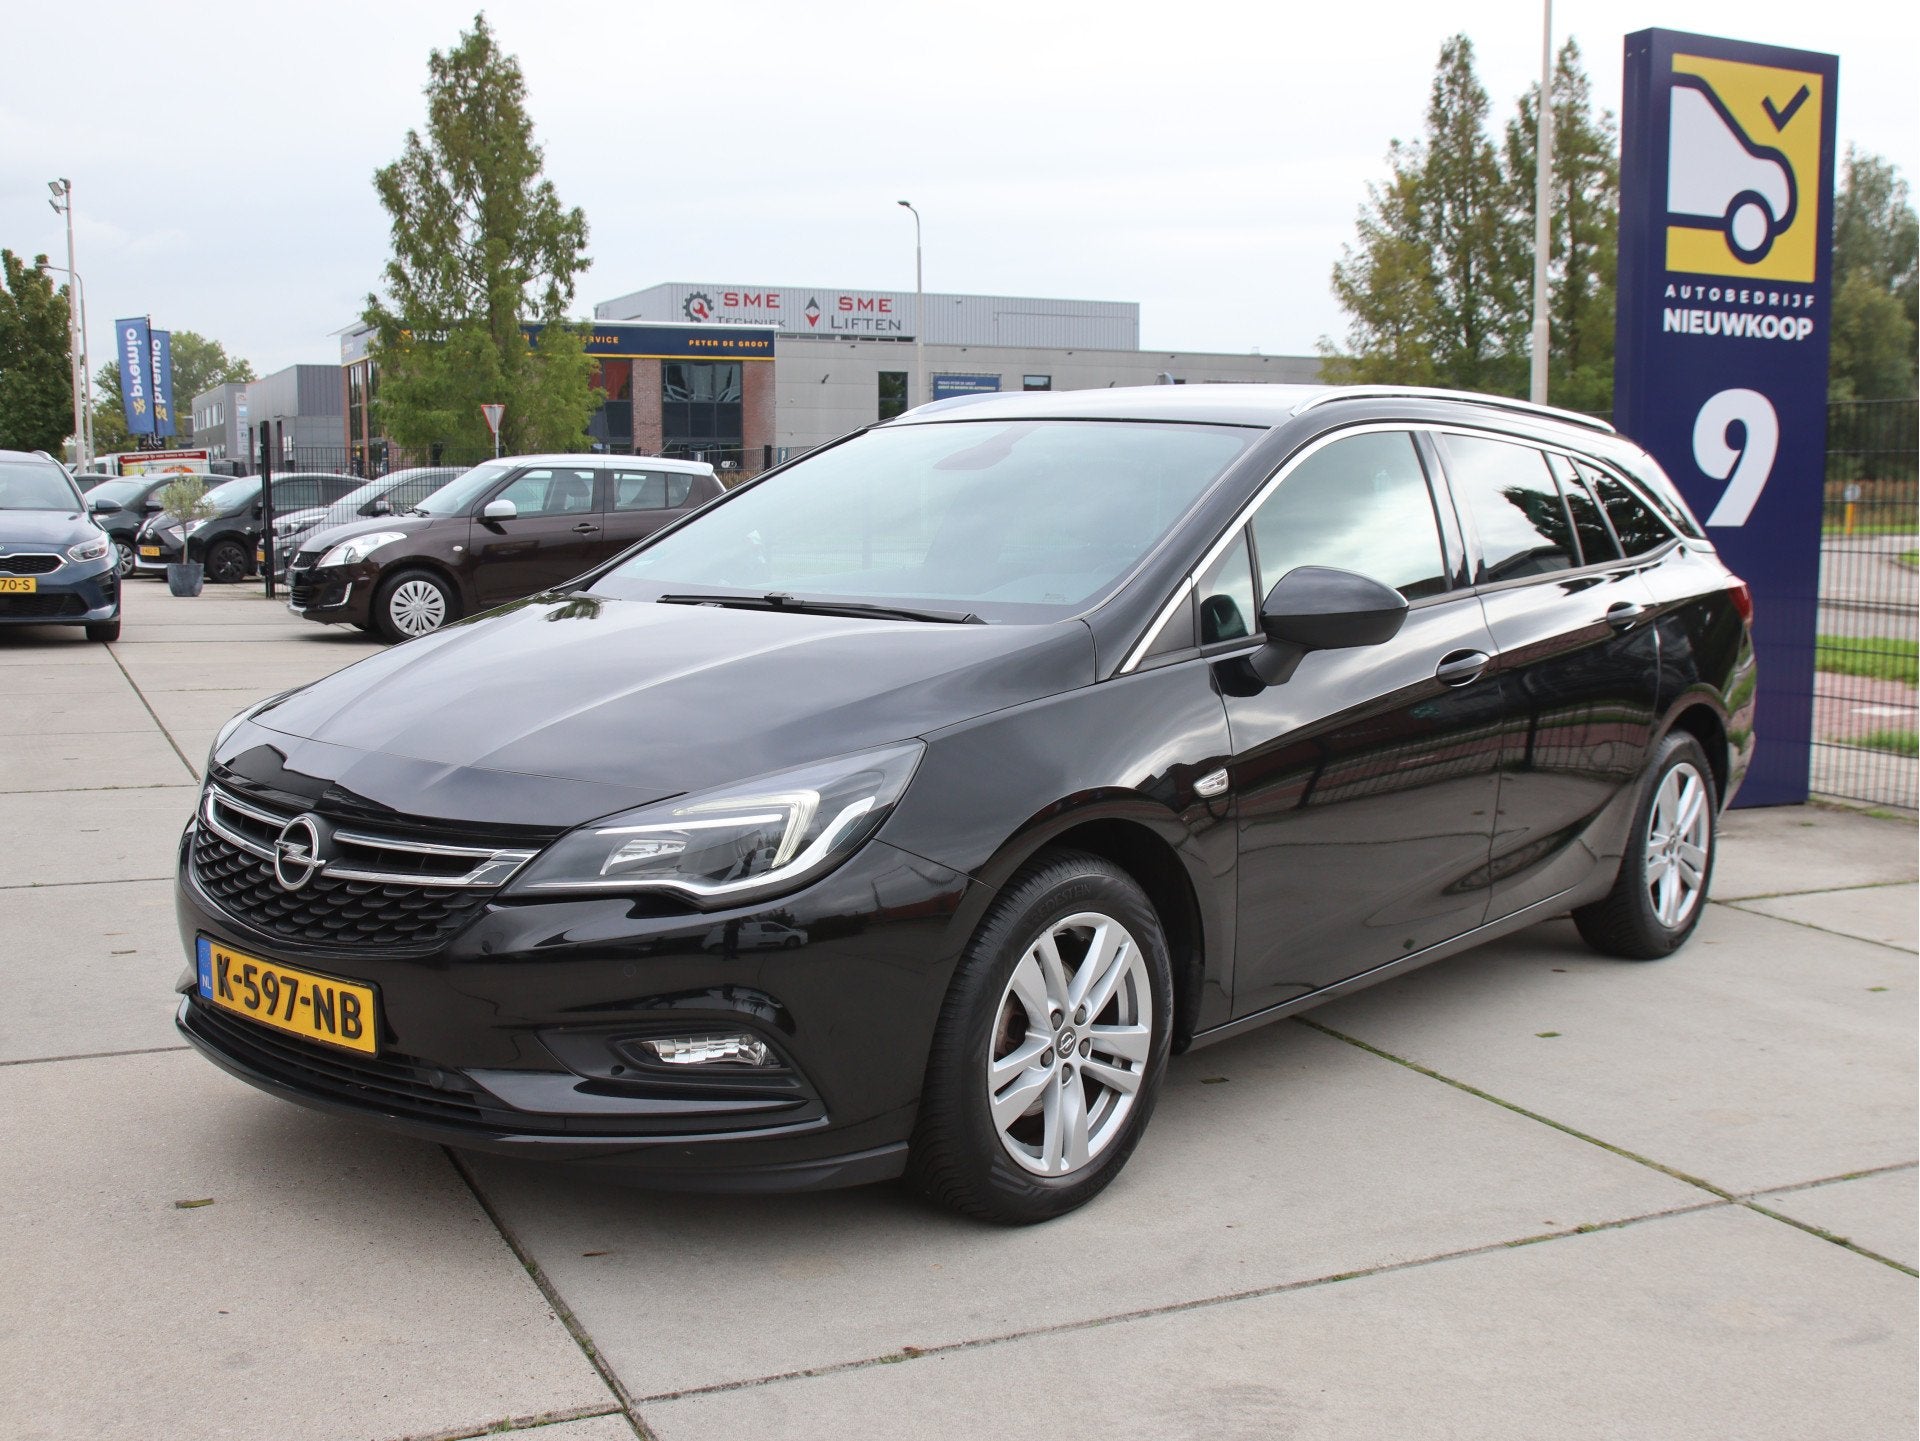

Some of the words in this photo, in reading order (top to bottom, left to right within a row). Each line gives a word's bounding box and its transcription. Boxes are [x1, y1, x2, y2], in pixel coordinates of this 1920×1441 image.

[723, 292, 781, 309] SME
[838, 297, 893, 313] SME
[1664, 284, 1816, 308] AUTOBEDRIJF
[830, 315, 902, 331] LIFTEN
[1662, 308, 1815, 341] NIEUWKOOP
[688, 339, 719, 347] PETER
[738, 340, 769, 348] GROOT
[151, 338, 167, 412] premio
[1692, 388, 1780, 527] 9
[201, 974, 212, 990] NL
[216, 953, 364, 1040] K-597-NB
